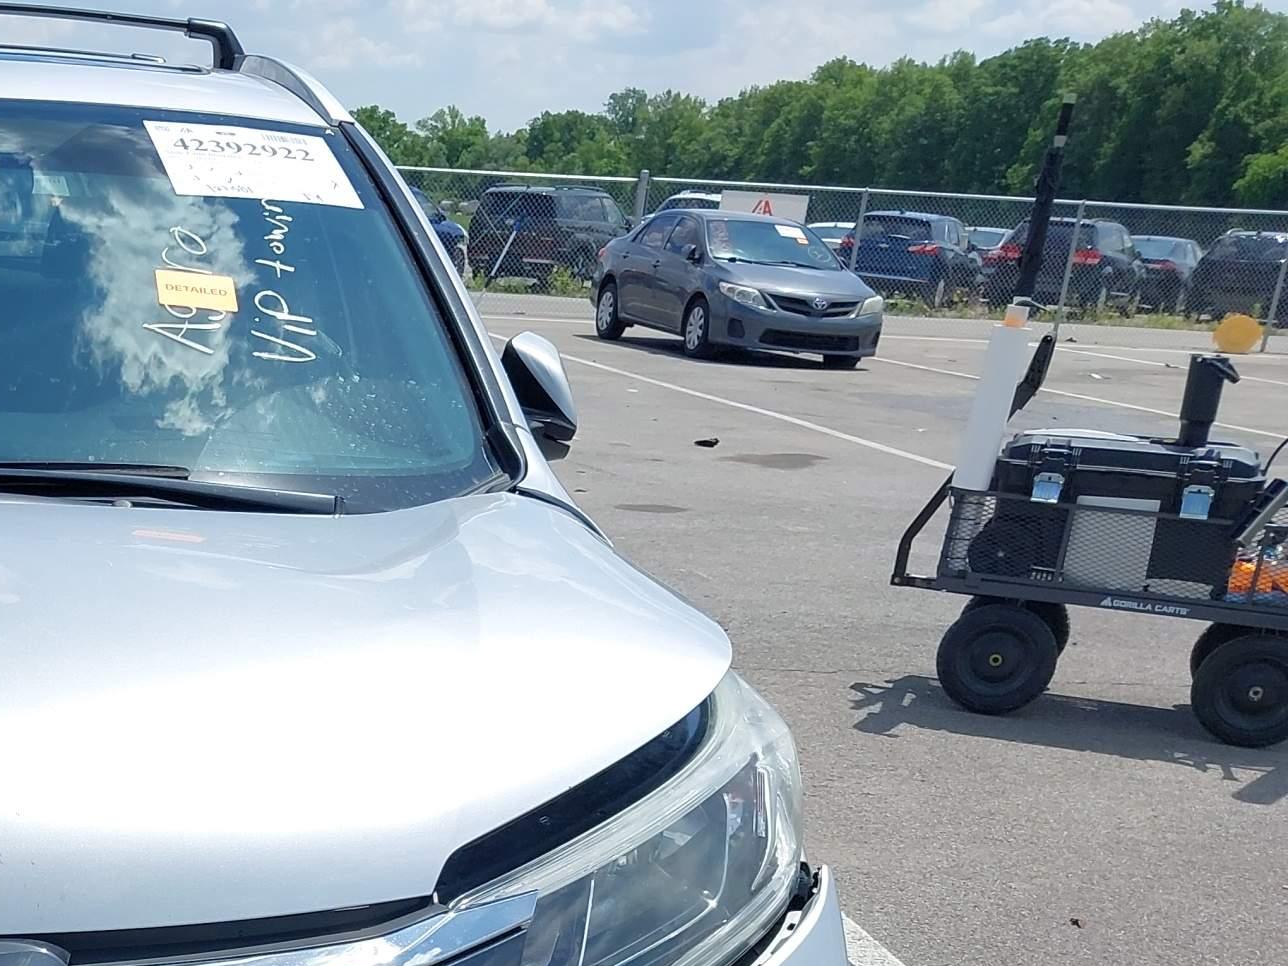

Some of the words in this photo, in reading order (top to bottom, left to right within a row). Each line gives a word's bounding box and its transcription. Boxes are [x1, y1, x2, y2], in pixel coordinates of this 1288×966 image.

[173, 137, 315, 162] 42392922
[164, 282, 228, 297] DETAILED
[1112, 599, 1152, 611] GORILLA
